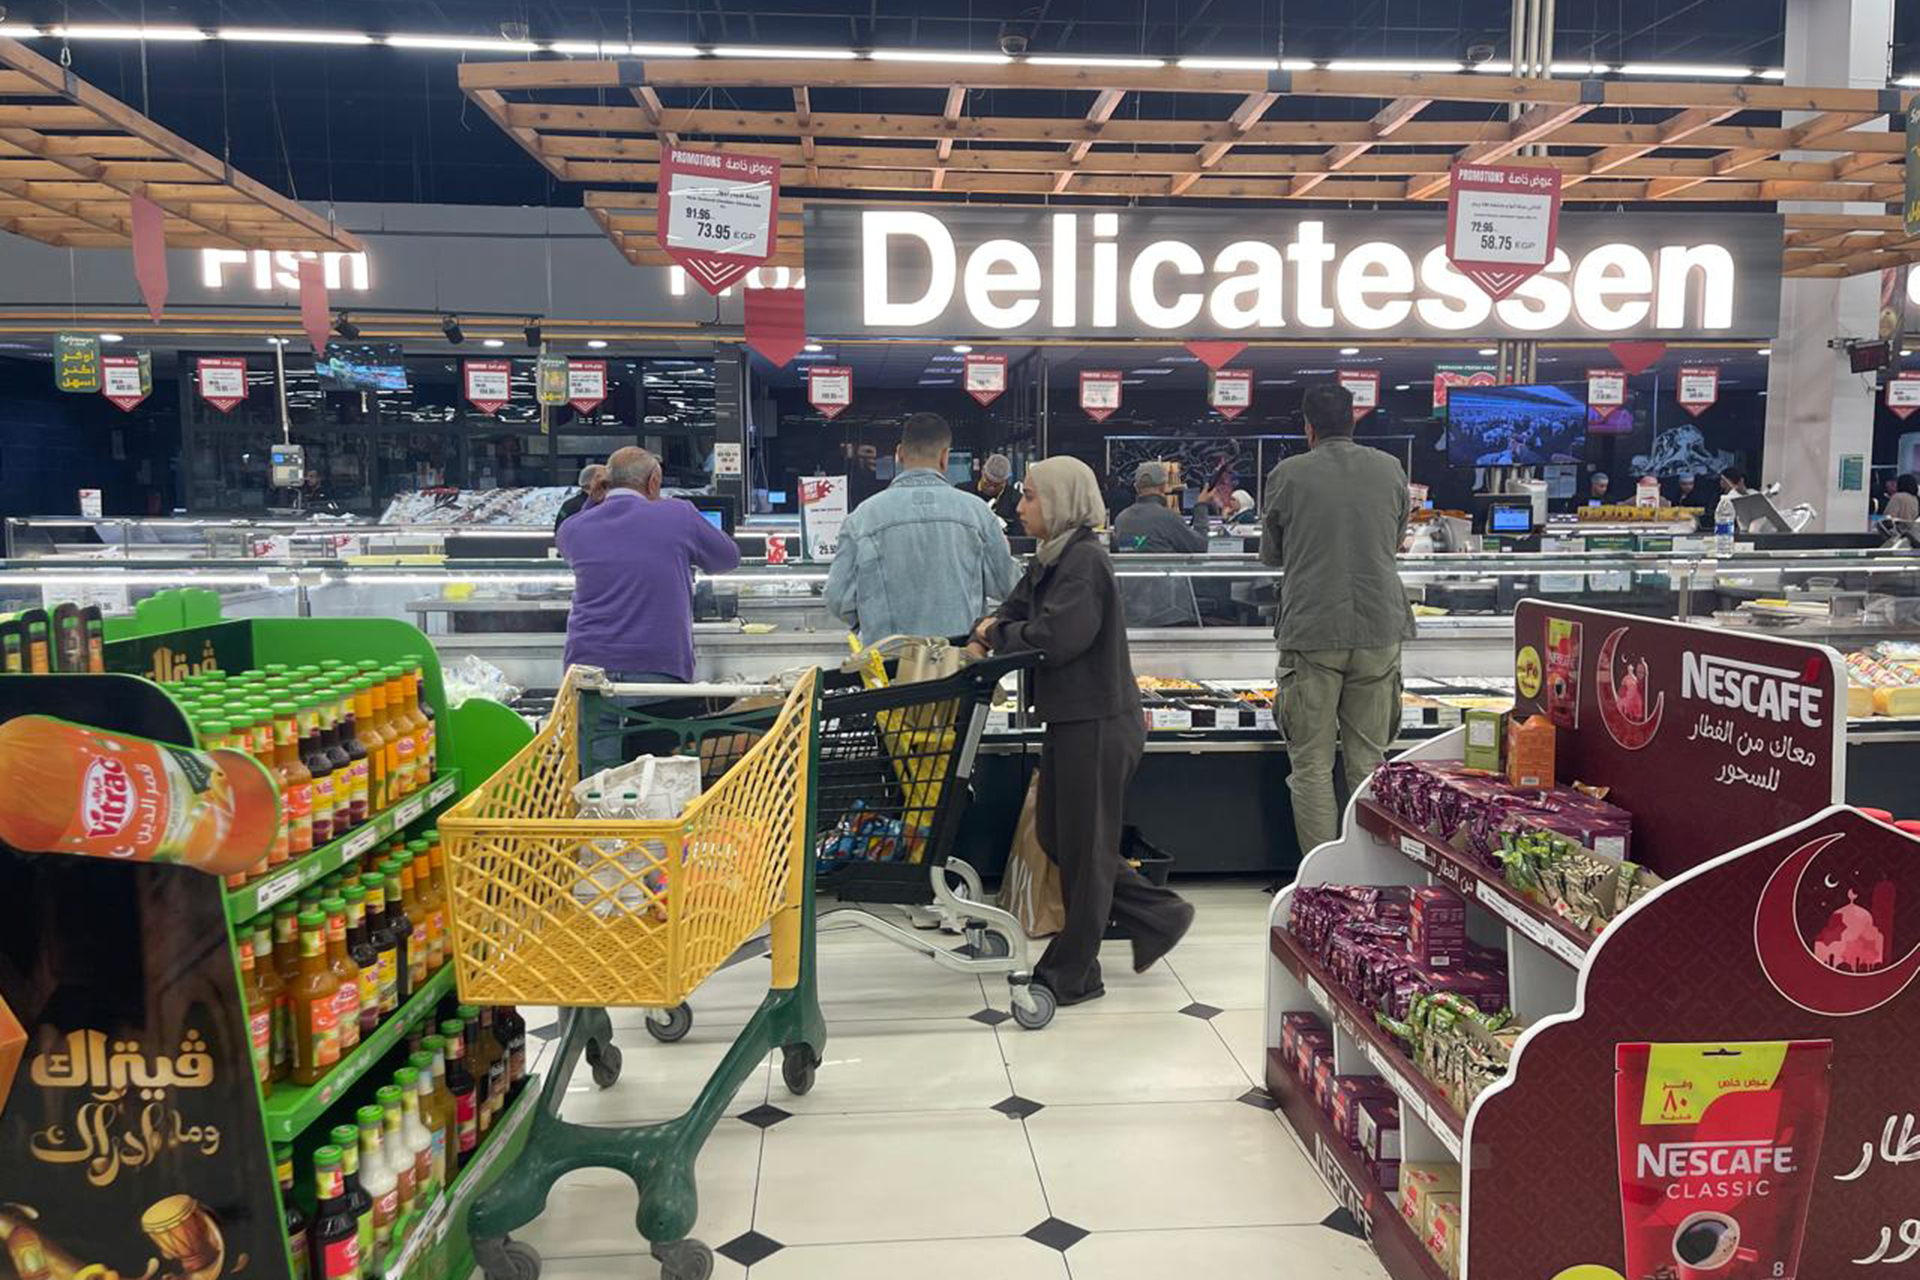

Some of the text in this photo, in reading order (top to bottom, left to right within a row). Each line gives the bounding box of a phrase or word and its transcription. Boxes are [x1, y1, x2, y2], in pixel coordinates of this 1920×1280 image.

[672, 151, 721, 168] PROMOTIONS
[725, 157, 774, 176] عروض خاصة
[1458, 168, 1504, 184] PROMOTIONS
[1508, 173, 1553, 188] عروض خاصة
[696, 222, 757, 240] 73.95 EGP
[1481, 235, 1536, 250] 58.75 EGP
[862, 211, 1735, 330] Delicatessen
[1687, 713, 1816, 767] معاك من الفطار
[1715, 762, 1781, 792] للسحور
[1717, 1077, 1768, 1089] عرض خاص
[1666, 1180, 1770, 1199] CLASSIC
[1772, 1261, 1784, 1277] 8
